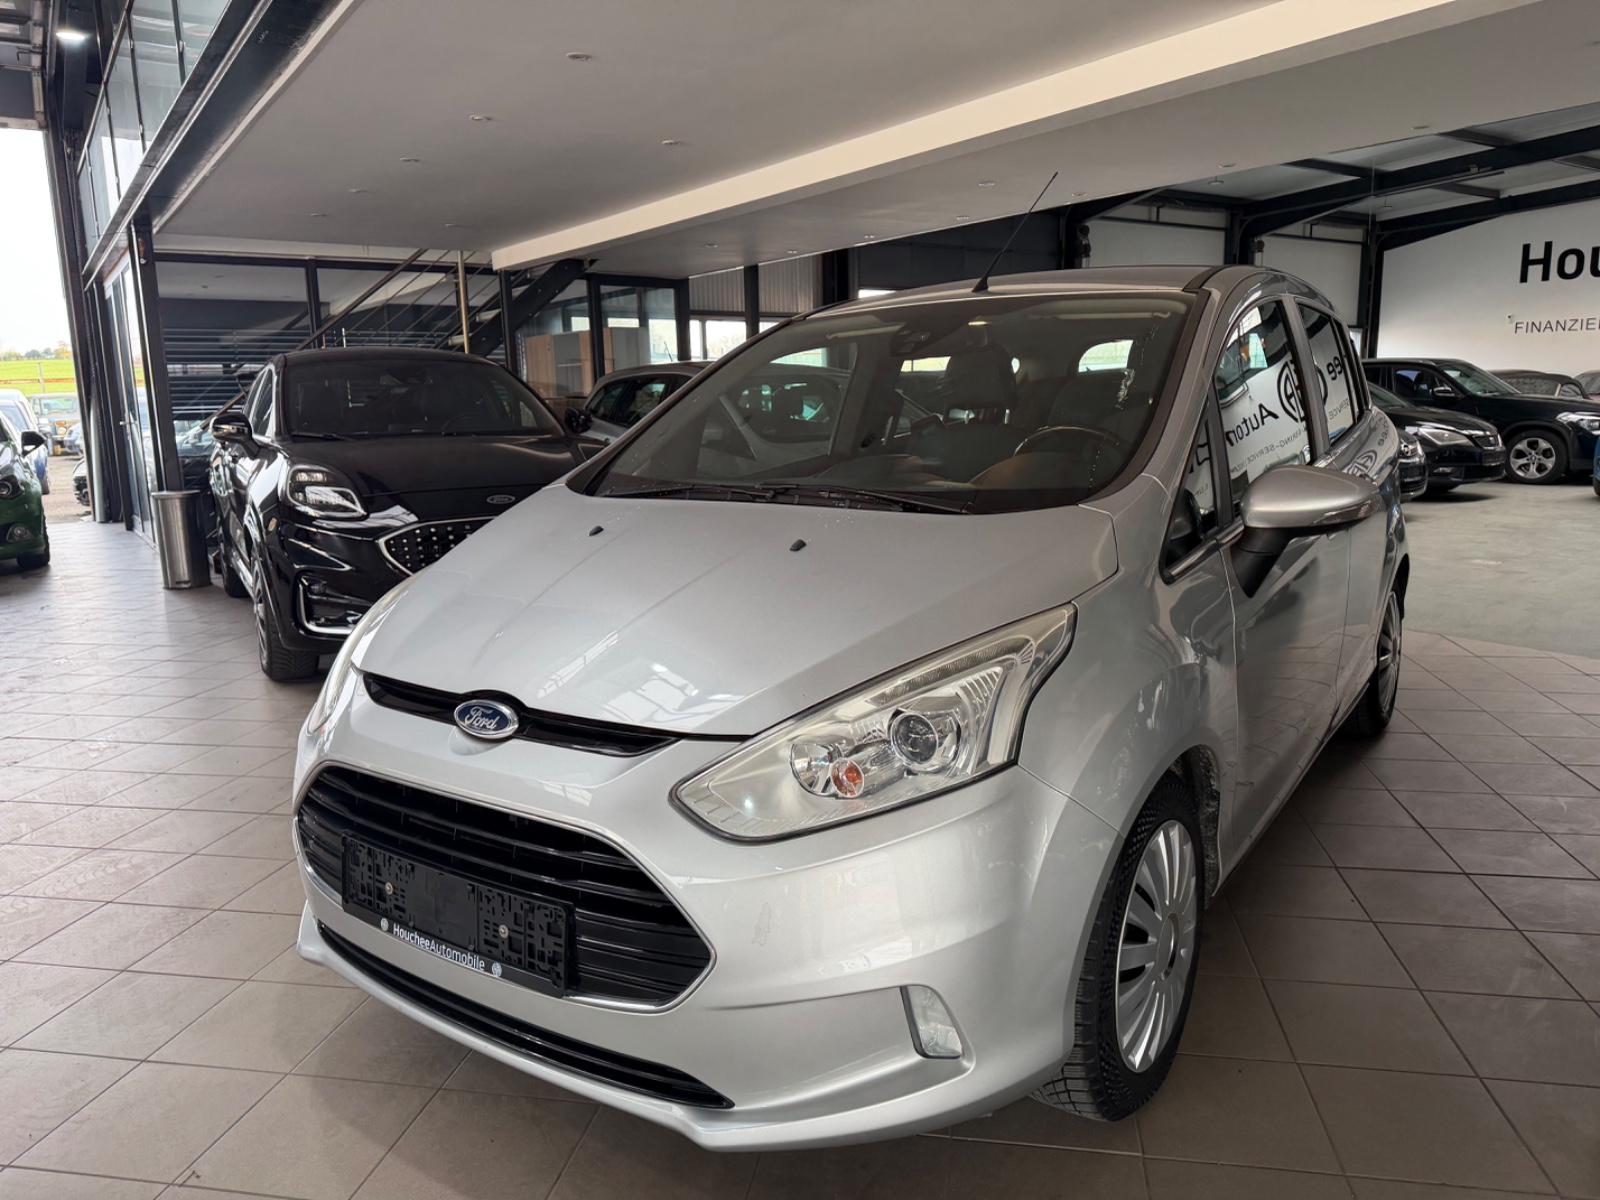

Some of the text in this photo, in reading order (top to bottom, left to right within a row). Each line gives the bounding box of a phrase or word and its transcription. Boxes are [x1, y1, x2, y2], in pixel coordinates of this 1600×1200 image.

[1514, 317, 1600, 334] FINANZIE
[464, 706, 500, 730] Ford
[393, 922, 485, 971] HoucheeAutomobile
